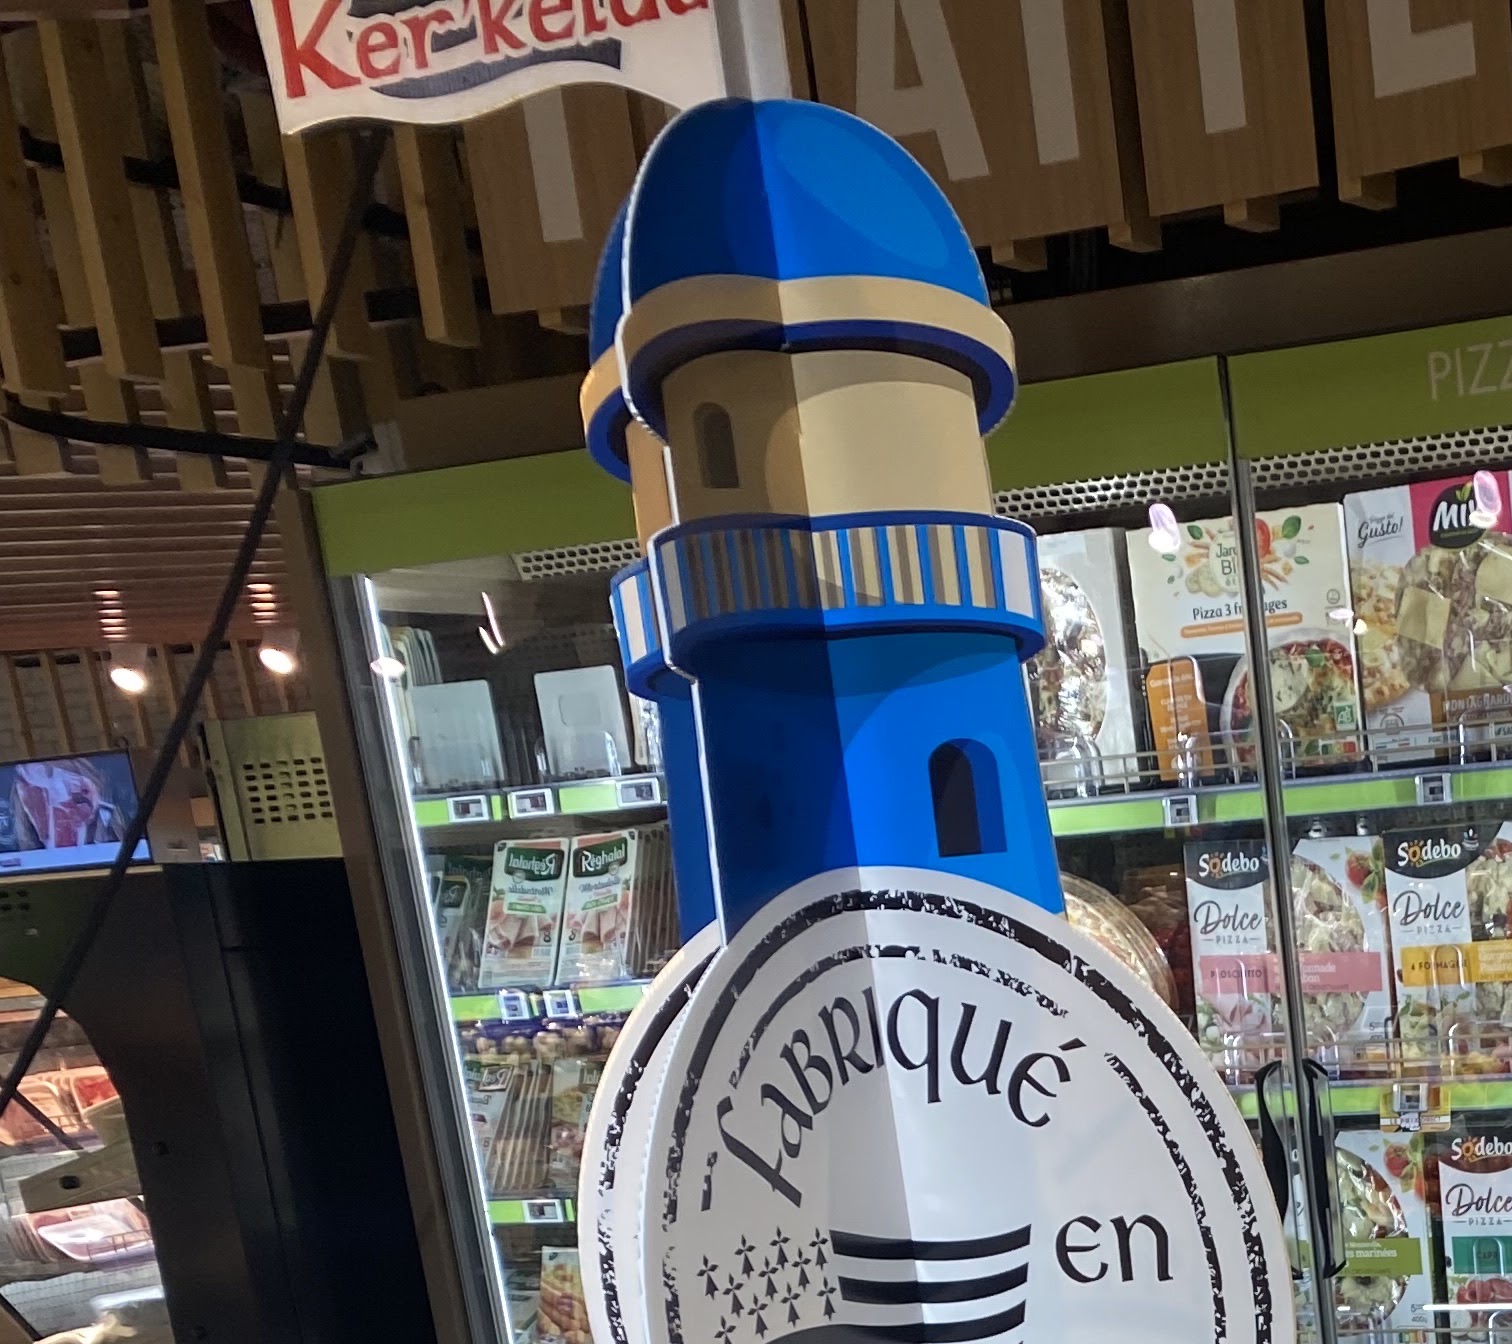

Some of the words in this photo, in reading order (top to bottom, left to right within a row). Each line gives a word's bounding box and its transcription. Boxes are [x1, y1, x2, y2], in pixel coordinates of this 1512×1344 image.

[1357, 514, 1404, 549] Gusto!
[1192, 606, 1224, 621] Pizza
[1193, 900, 1264, 937] Dolce
[1392, 889, 1465, 928] Dolce
